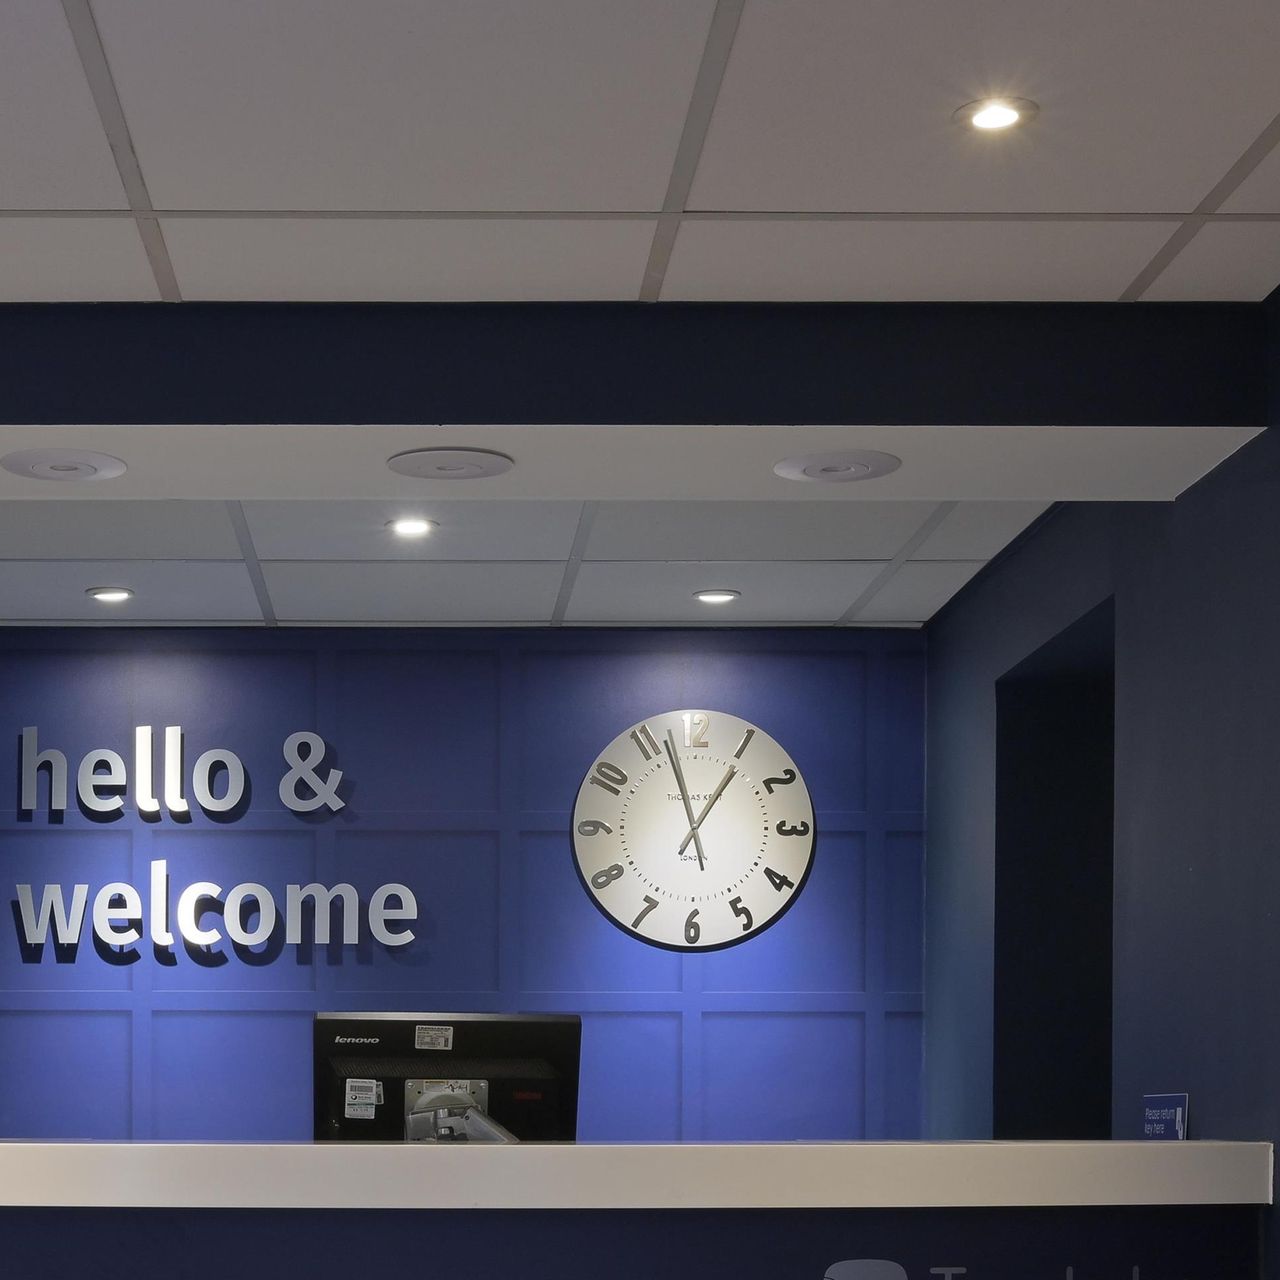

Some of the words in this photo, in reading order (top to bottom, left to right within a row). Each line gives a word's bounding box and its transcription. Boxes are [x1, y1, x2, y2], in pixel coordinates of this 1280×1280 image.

[630, 724, 662, 761] 11
[682, 713, 709, 748] 12
[733, 728, 755, 760] 1
[20, 725, 245, 813] hello
[278, 731, 346, 813] &
[589, 761, 628, 796] 10
[762, 768, 796, 795] 2
[577, 820, 613, 837] 9
[776, 820, 810, 837] 3
[590, 863, 625, 890] 8
[763, 866, 795, 893] 4
[15, 858, 418, 947] welcome
[631, 894, 660, 930] 7
[728, 896, 754, 932] 5
[684, 908, 701, 944] 6
[334, 1035, 381, 1044] lenovo
